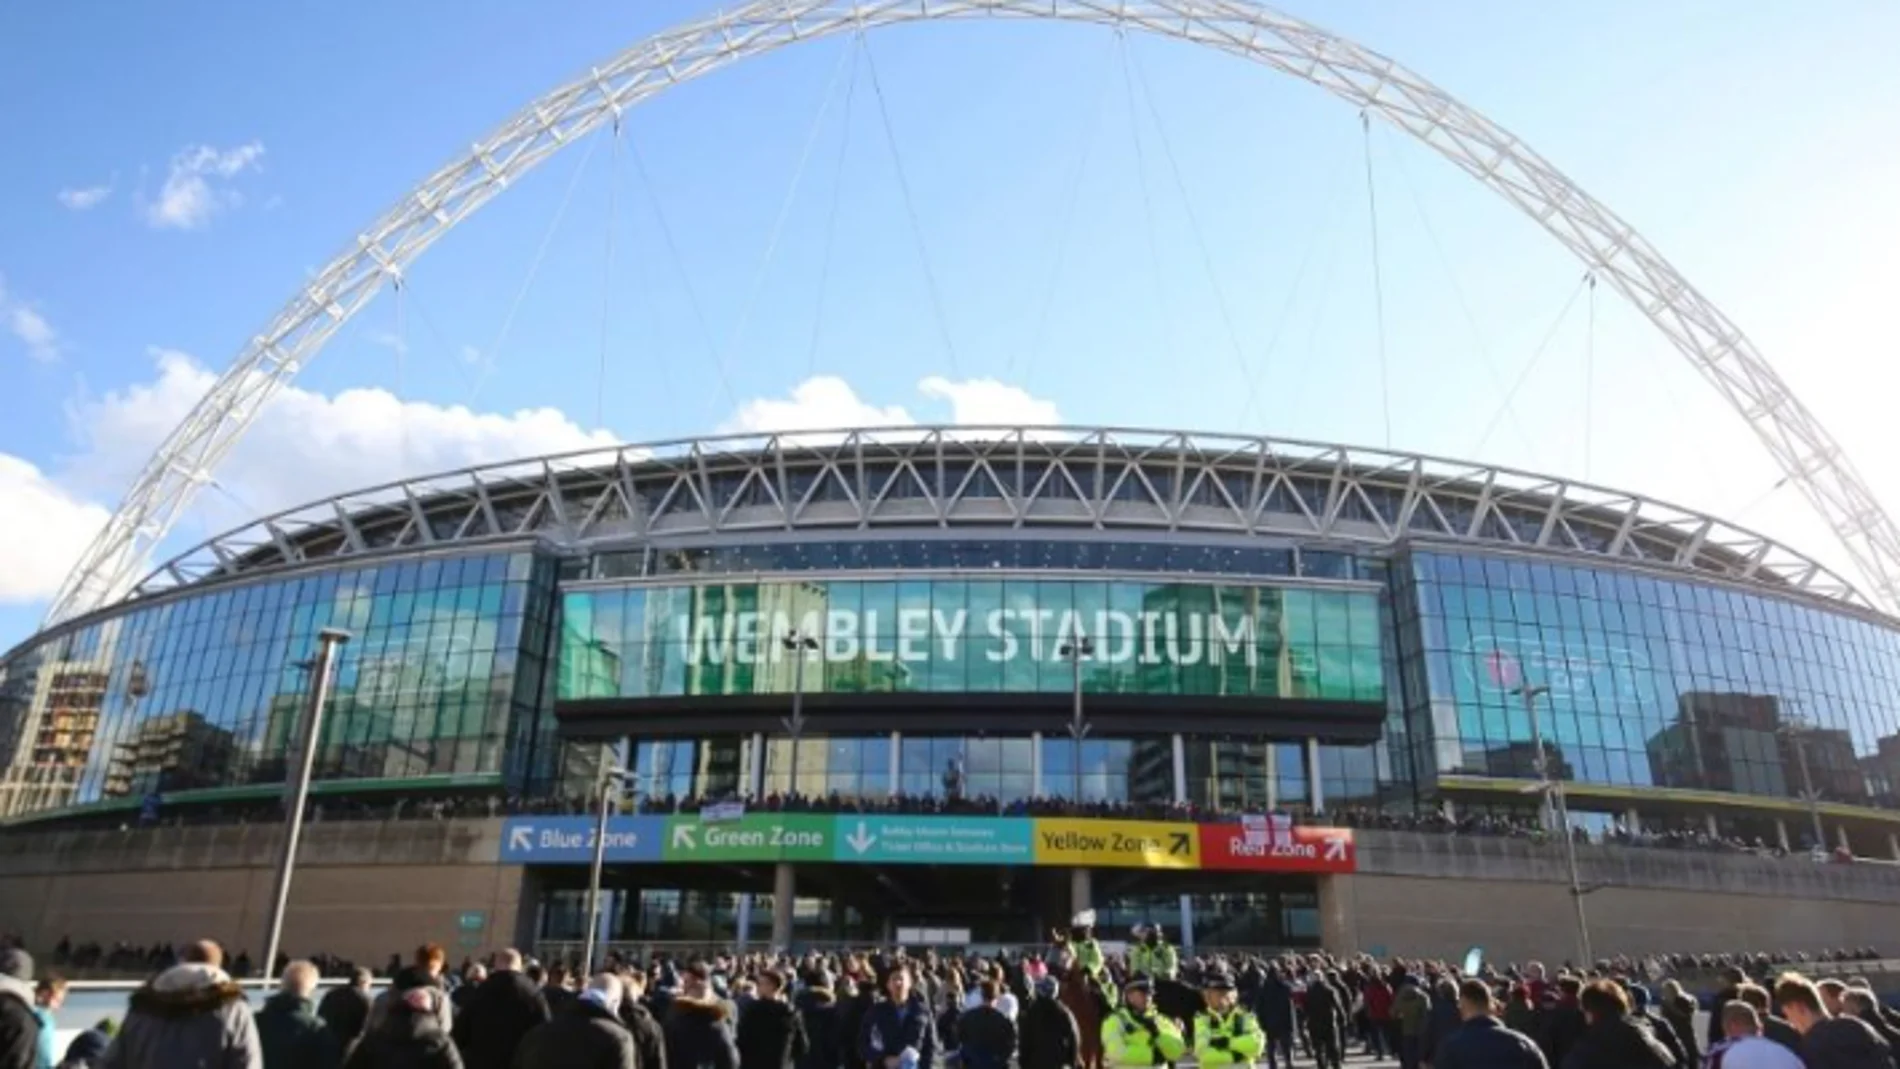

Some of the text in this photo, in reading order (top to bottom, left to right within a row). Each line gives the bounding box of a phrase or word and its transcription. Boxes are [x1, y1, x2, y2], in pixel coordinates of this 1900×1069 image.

[678, 607, 1258, 667] WEMBLEY STADIUM
[539, 828, 583, 848] Blue
[704, 825, 824, 847] Green Zone
[1041, 831, 1107, 851] Yellow
